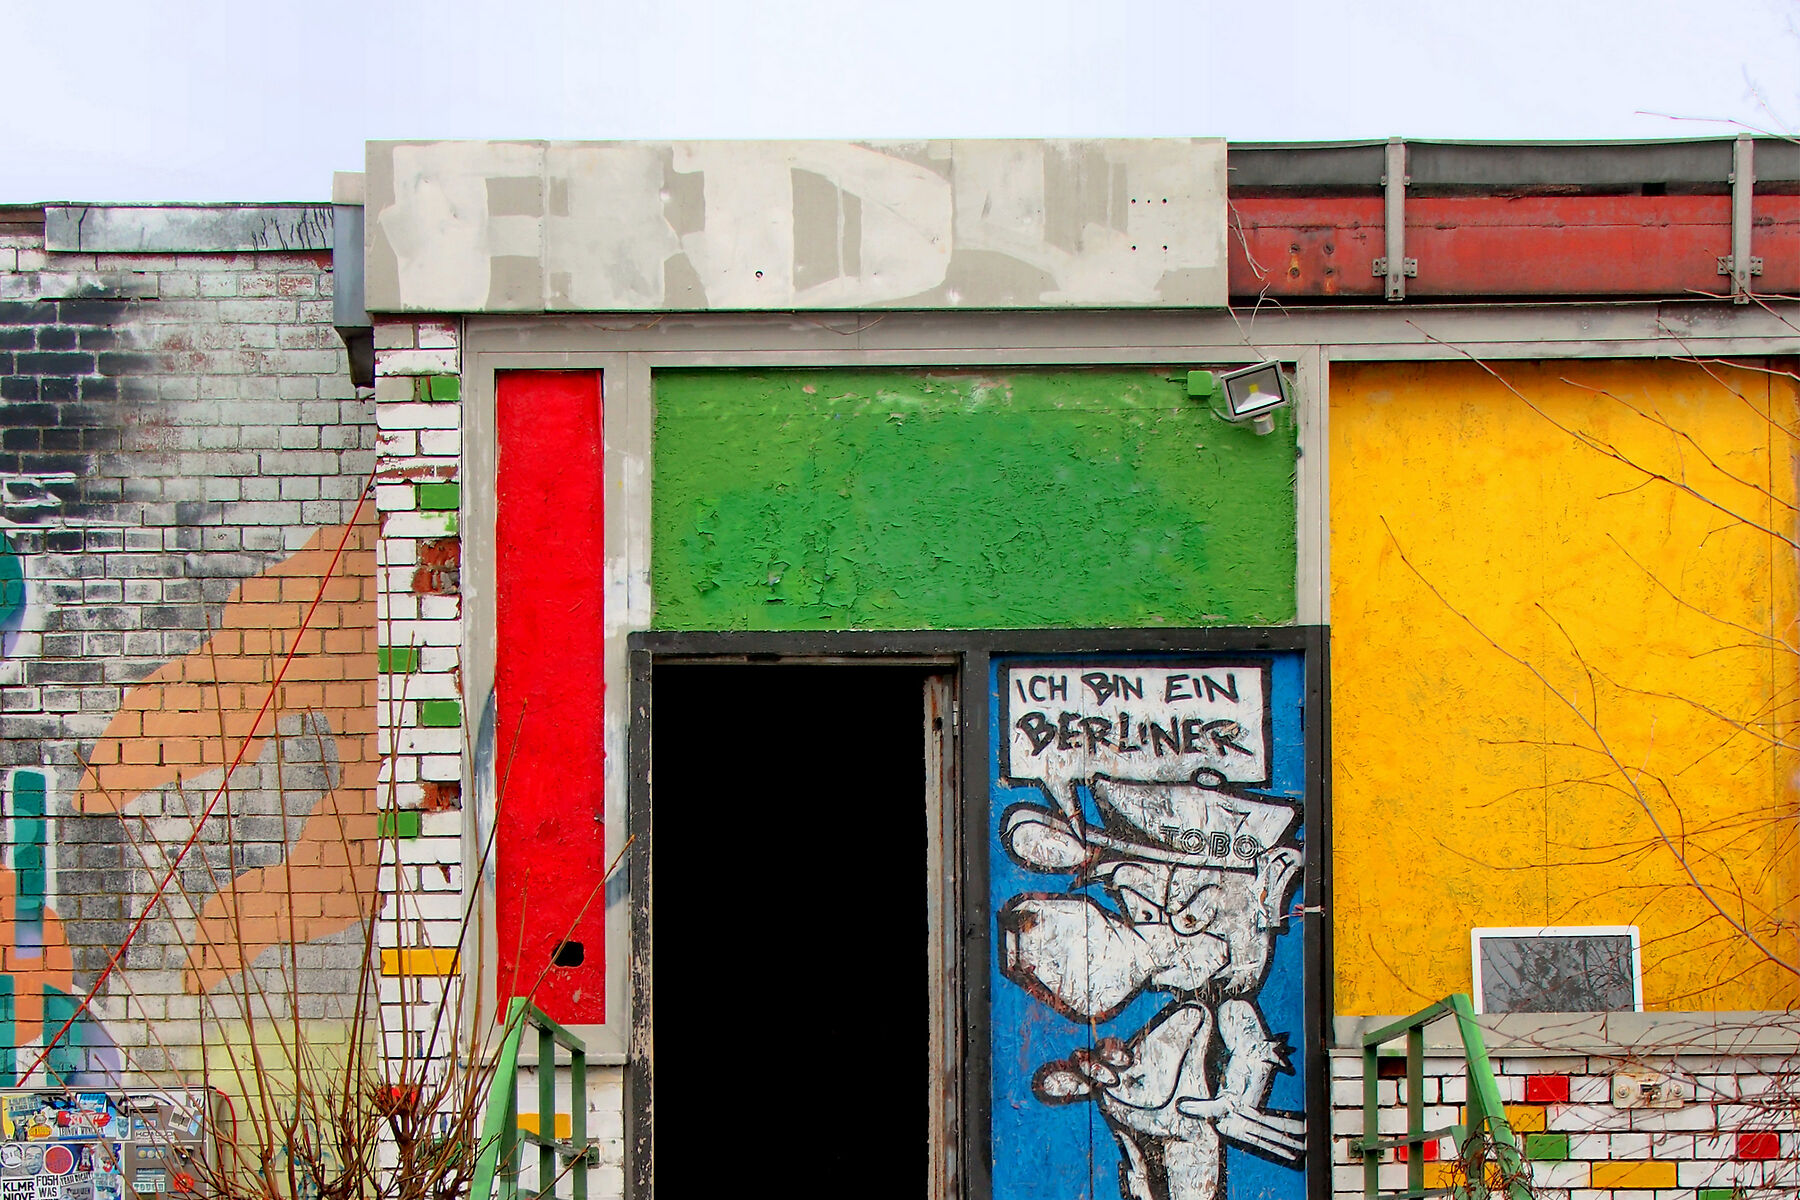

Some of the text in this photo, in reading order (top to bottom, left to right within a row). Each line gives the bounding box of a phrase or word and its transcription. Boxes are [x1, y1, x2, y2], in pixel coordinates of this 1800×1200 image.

[1015, 671, 1240, 706] ICH BIN EIN
[1013, 711, 1255, 757] BERLINER
[1159, 824, 1263, 860] TOBO
[3, 1182, 35, 1192] KLMR
[39, 1187, 58, 1198] WAS
